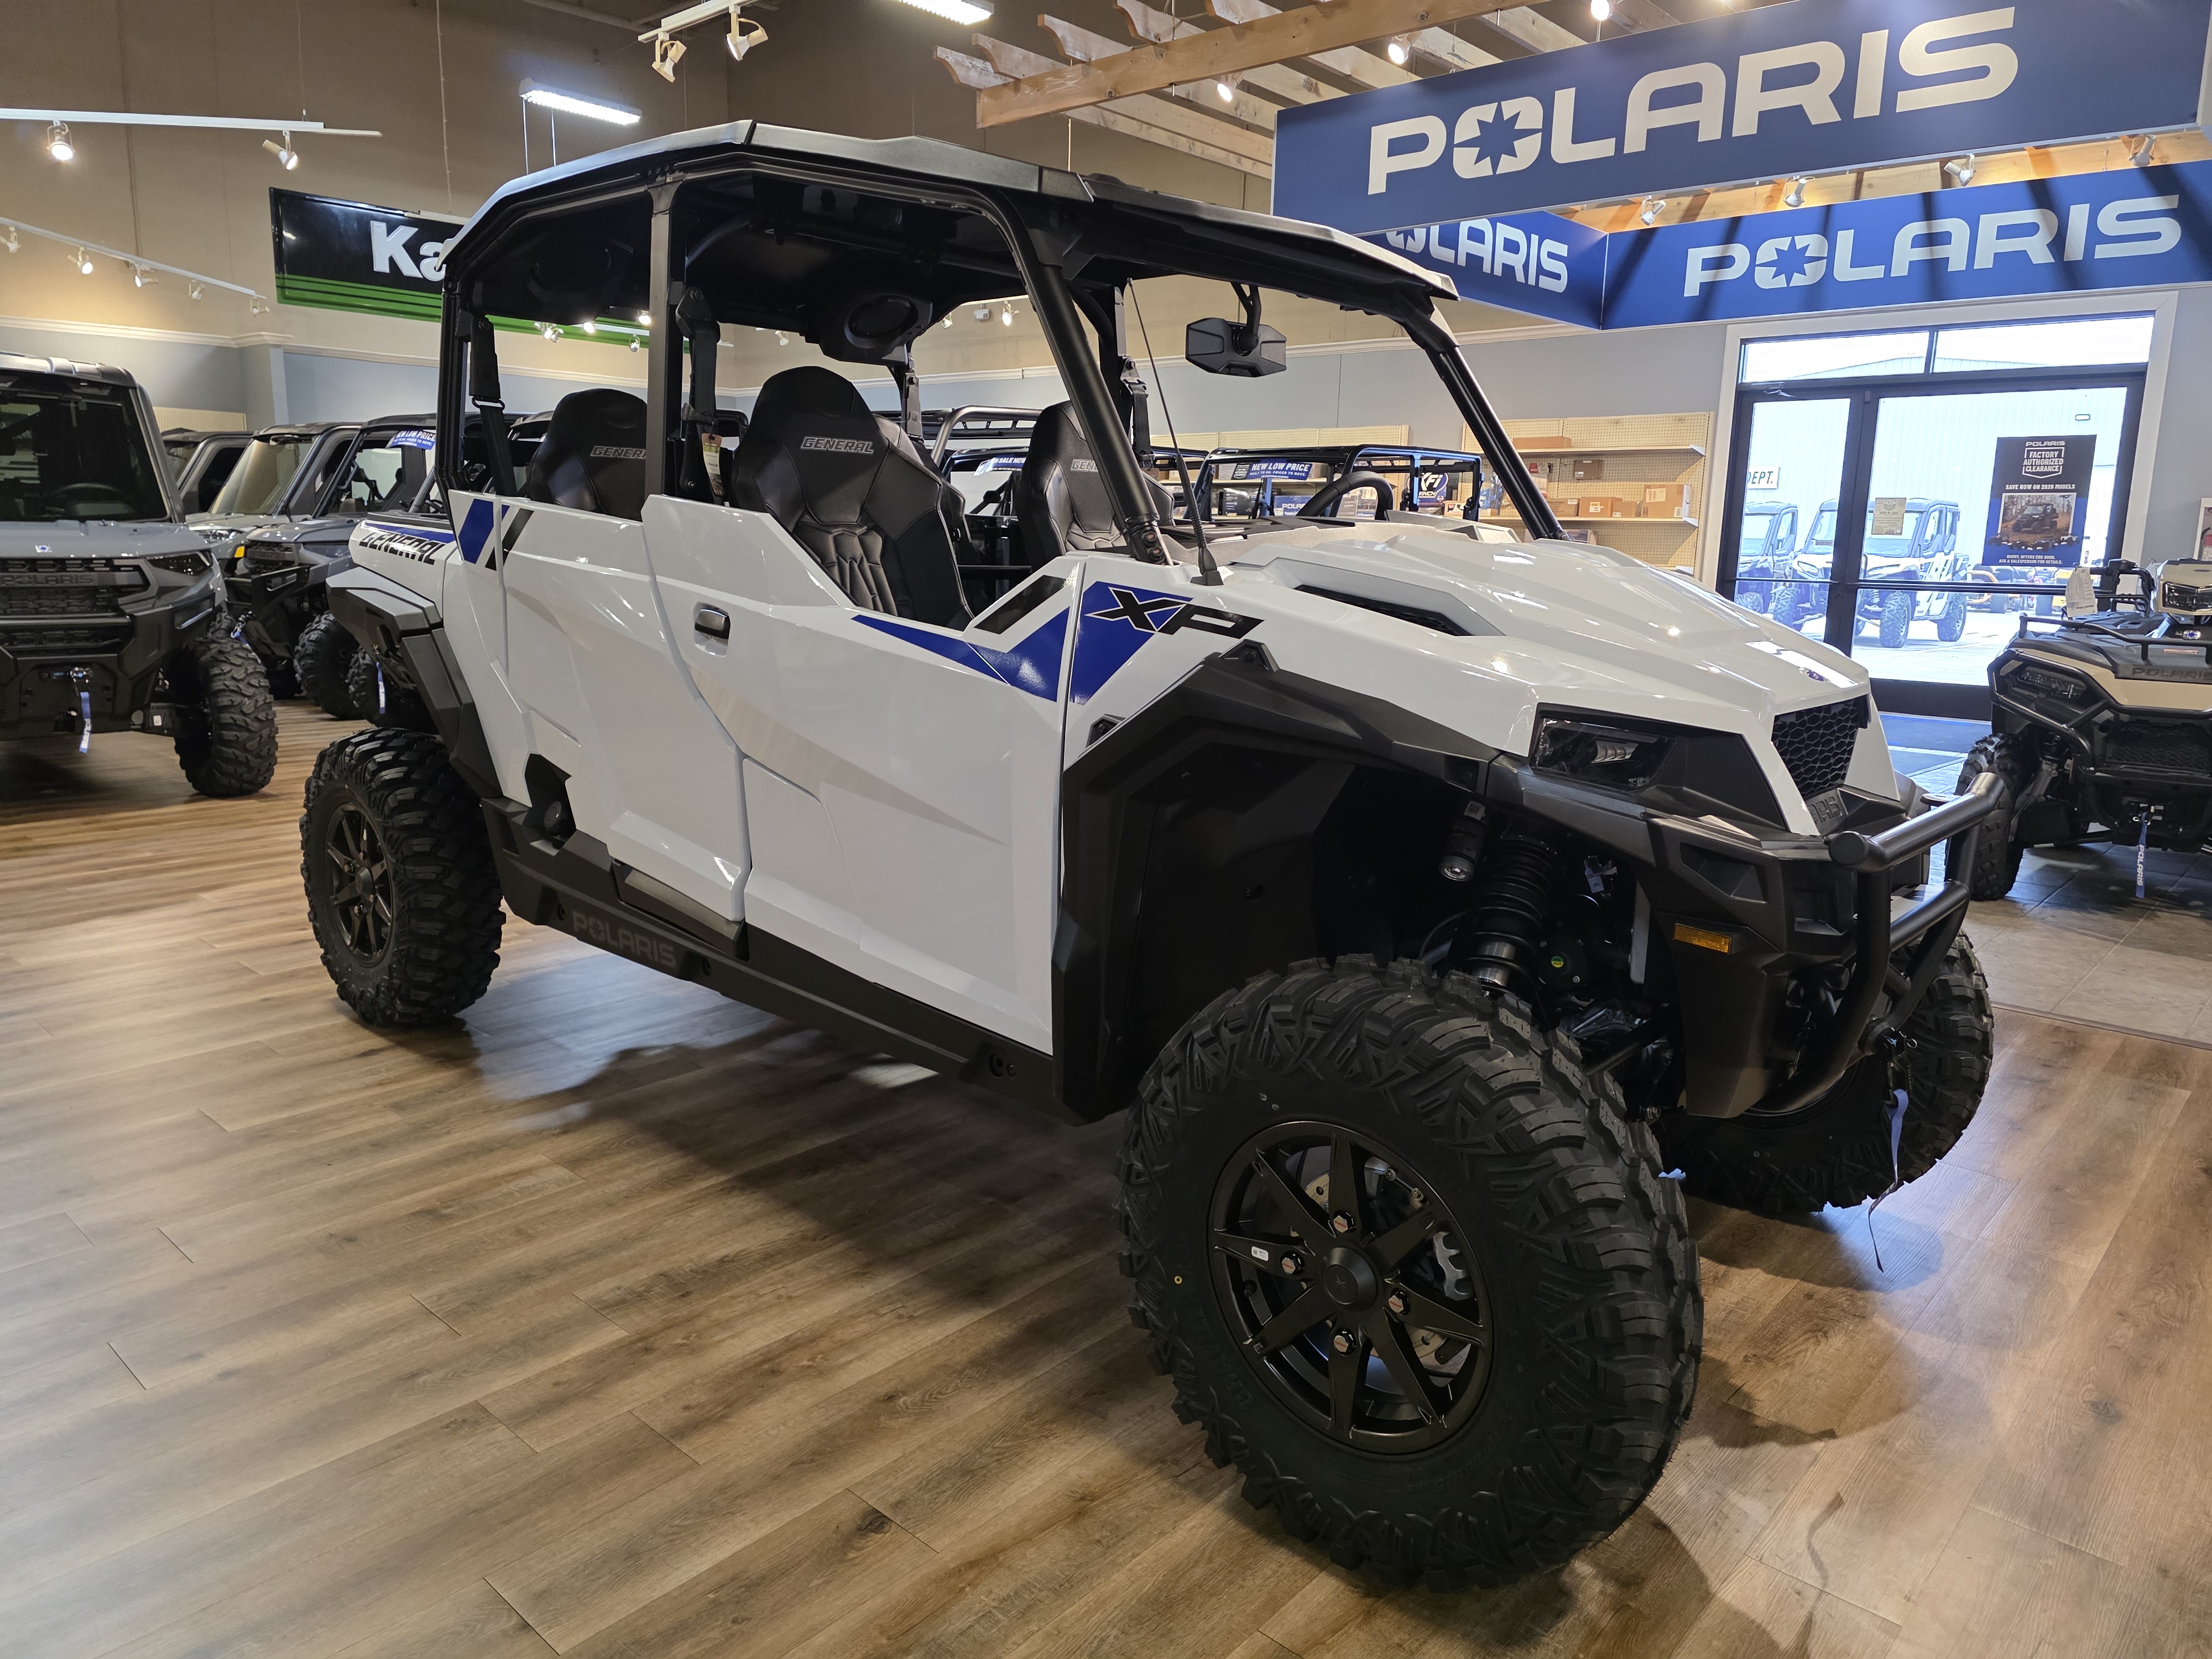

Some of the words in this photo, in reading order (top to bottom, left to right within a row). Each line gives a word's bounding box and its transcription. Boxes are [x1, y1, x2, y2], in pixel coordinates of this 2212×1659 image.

[1368, 7, 2019, 195] POLARIS
[370, 220, 447, 281] Ka
[1684, 195, 2182, 298] POLARIS
[416, 431, 436, 441] PRICE
[800, 436, 873, 455] GENERAL
[1286, 463, 1310, 472] PRICE
[359, 531, 446, 565] GENERAL
[1084, 586, 1266, 639] XP
[2137, 844, 2145, 886] POLARIS
[572, 911, 676, 969] POLARIS
